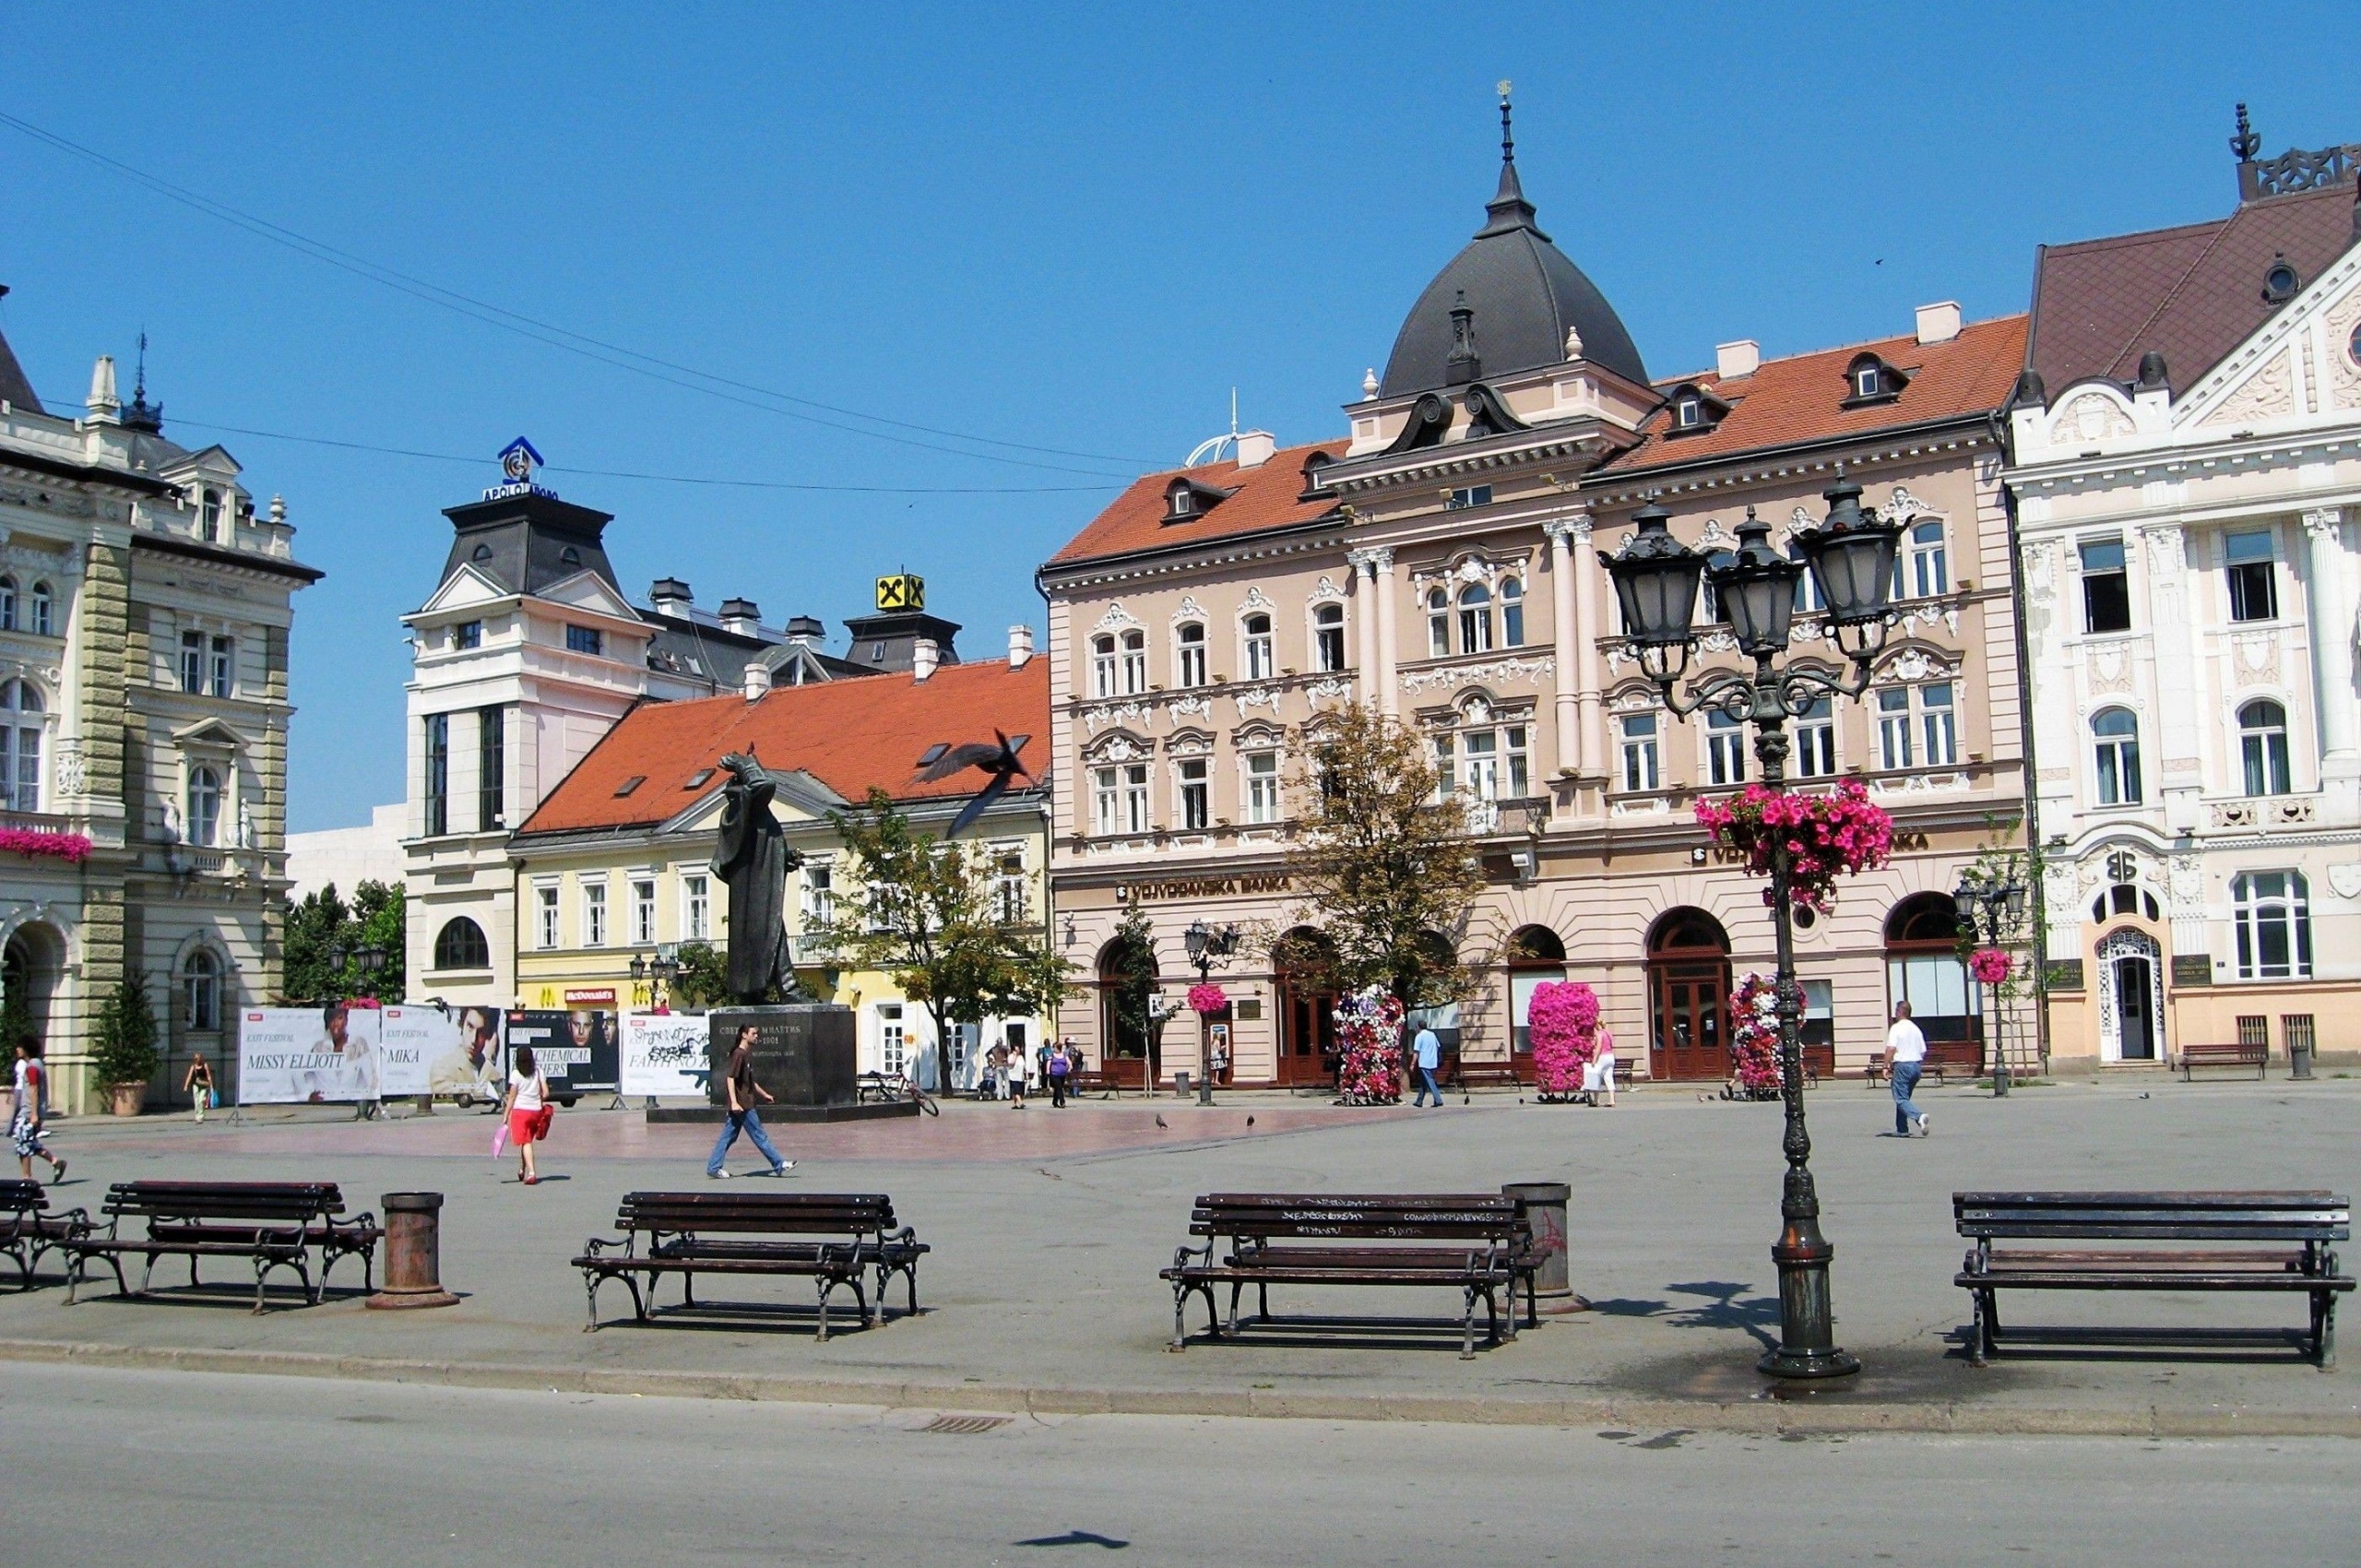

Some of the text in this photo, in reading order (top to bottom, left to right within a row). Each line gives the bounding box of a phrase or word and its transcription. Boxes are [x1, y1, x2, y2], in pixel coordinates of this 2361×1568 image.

[484, 484, 522, 502] APOLO
[1890, 832, 1928, 851] NKA
[1241, 876, 1292, 894] BANKA
[565, 991, 613, 1001] McDonald's
[246, 1053, 344, 1070] MISSY ELLIOTT
[387, 1049, 419, 1063] MIKA
[535, 1050, 589, 1062] CHEMICAL
